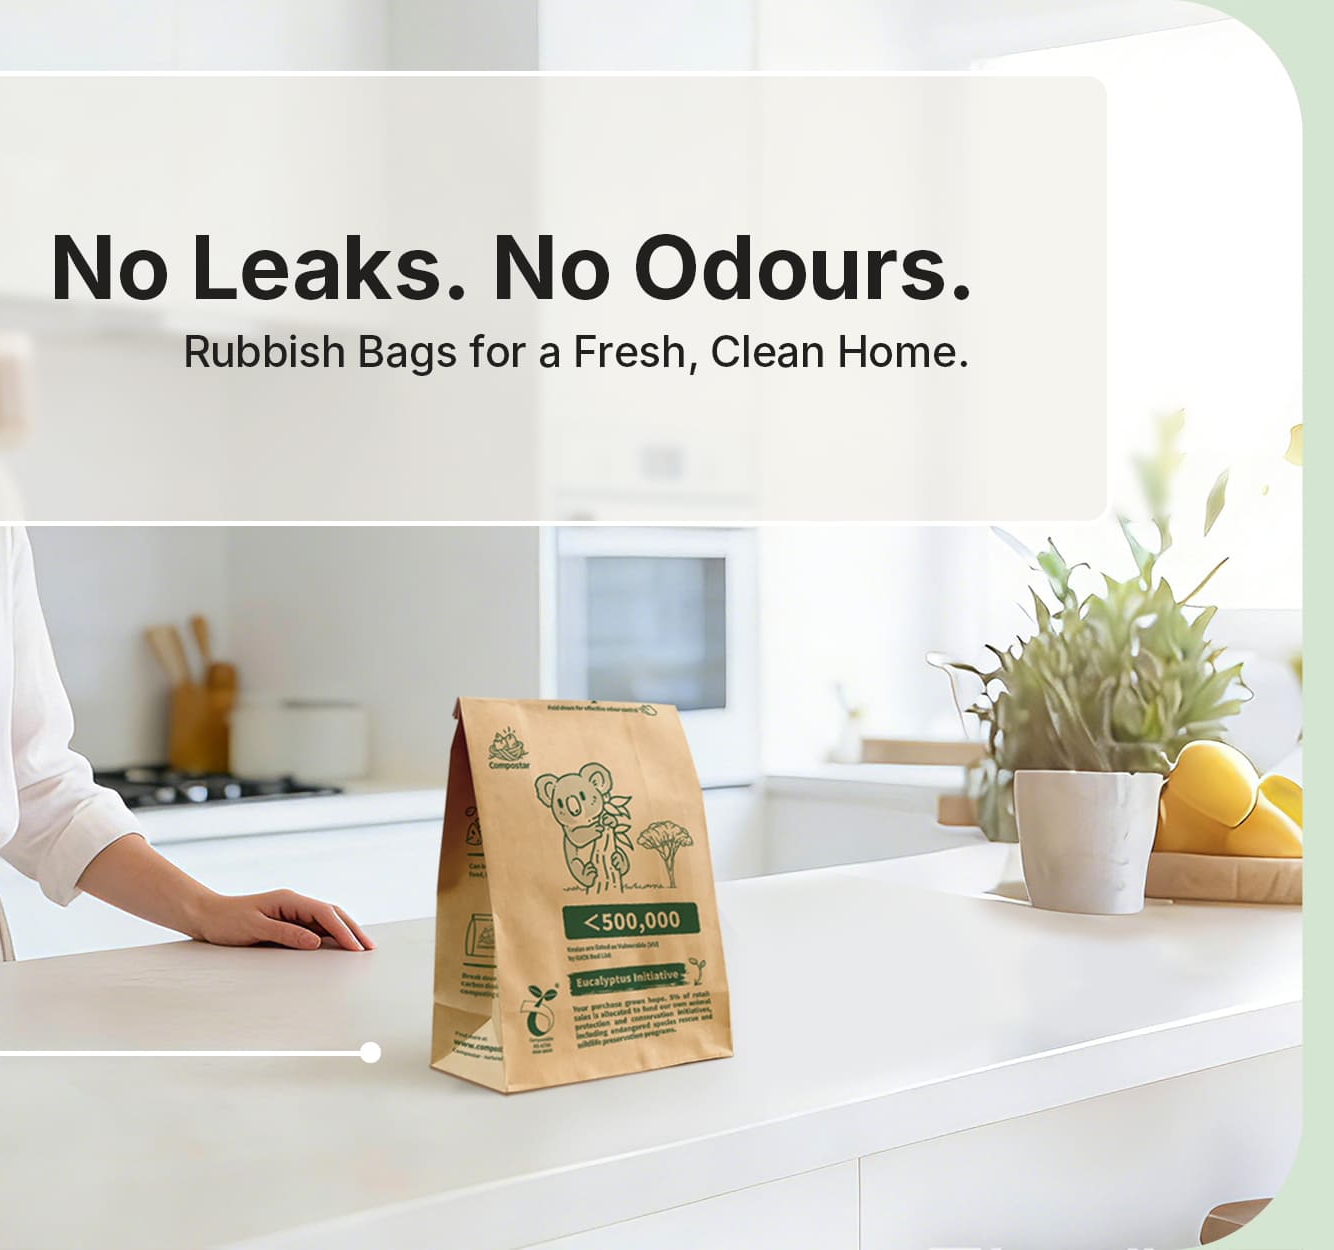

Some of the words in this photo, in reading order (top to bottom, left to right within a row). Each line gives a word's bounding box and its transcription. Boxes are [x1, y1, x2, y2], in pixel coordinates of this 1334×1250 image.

[489, 761, 530, 771] Compostar
[584, 911, 680, 934] <500,000
[576, 974, 631, 988] Eucalyptus
[634, 970, 679, 983] Initiative
